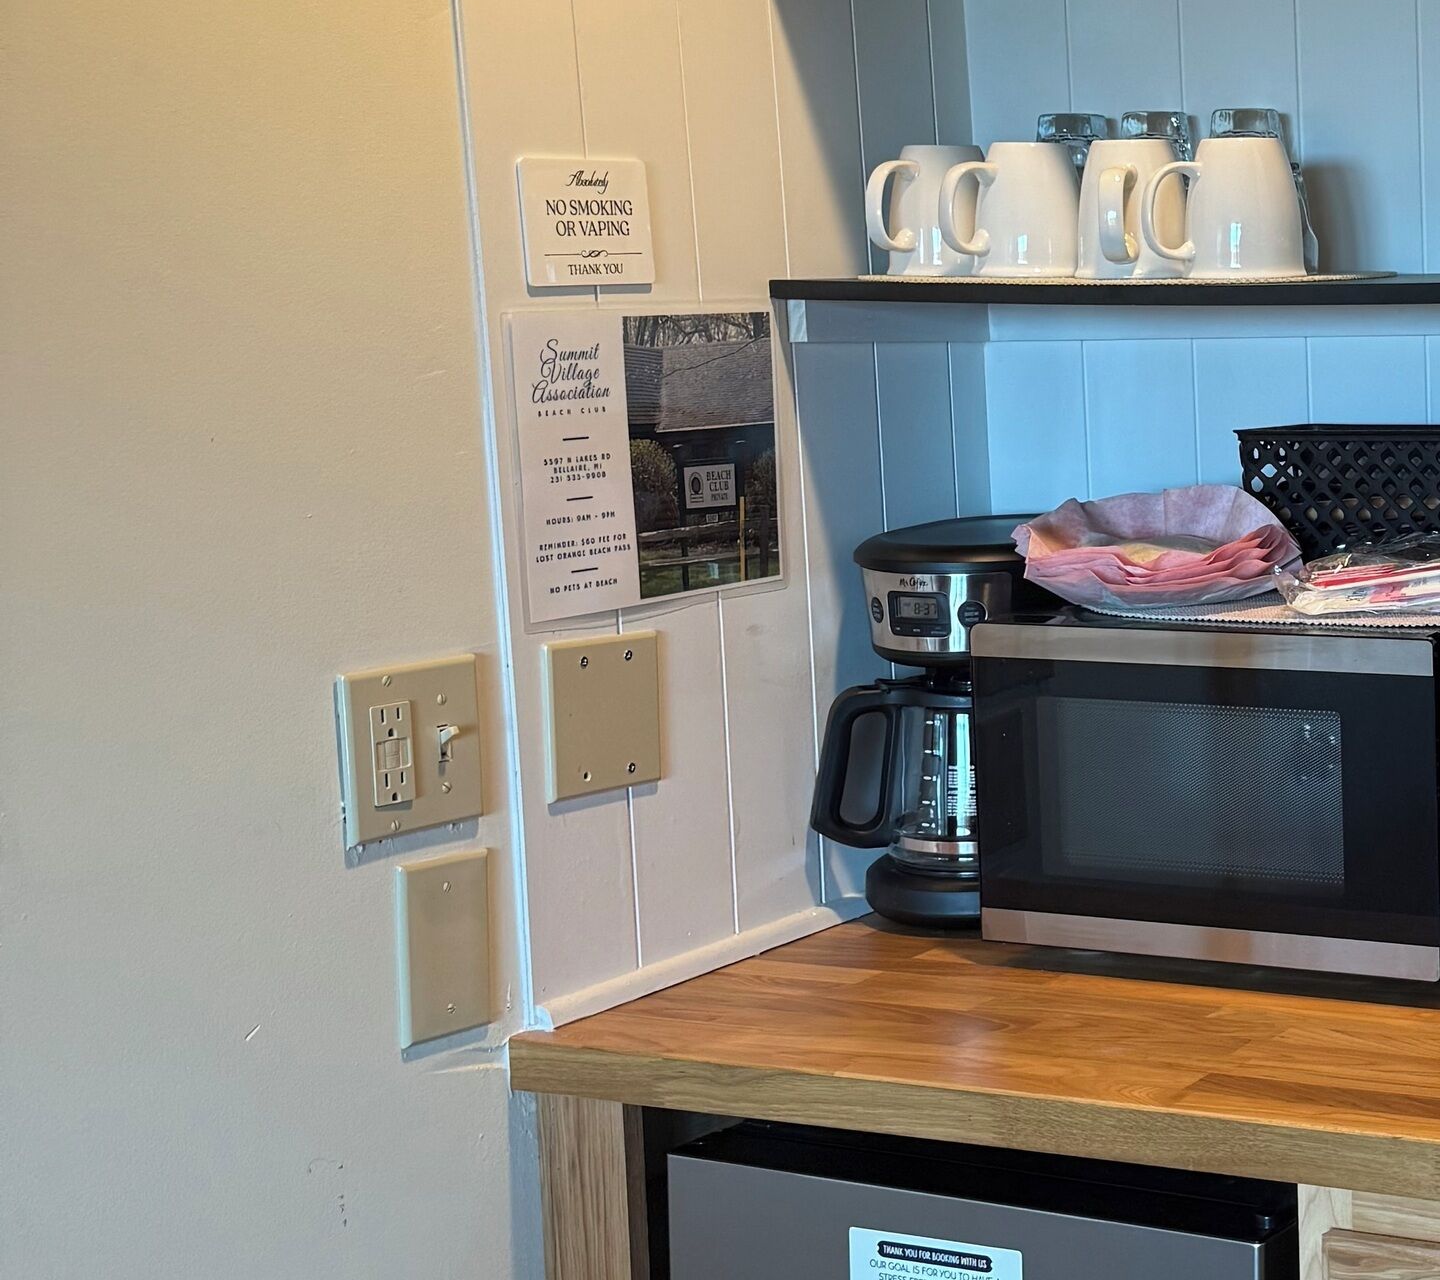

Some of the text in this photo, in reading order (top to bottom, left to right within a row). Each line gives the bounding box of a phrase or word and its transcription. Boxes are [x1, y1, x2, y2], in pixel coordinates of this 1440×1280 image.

[546, 200, 633, 215] NO SMOKING
[556, 220, 630, 236] OR VAPING
[568, 263, 623, 275] THANK YOU
[540, 338, 600, 364] Summit
[540, 358, 600, 388] Village
[532, 380, 610, 403] Association
[538, 406, 606, 417] BEACH CLUB
[706, 470, 731, 481] BEACH
[710, 481, 729, 491] CLUB
[546, 516, 573, 525] HOURS:
[536, 554, 554, 563] LOST
[557, 550, 585, 560] ORANGE
[590, 547, 611, 555] BEACH
[550, 586, 560, 594] NO
[564, 583, 580, 592] PETS
[596, 578, 618, 587] BEACH
[883, 1244, 987, 1268] THANK YOU FOR BOOKING WITH US
[869, 1259, 886, 1269] OUR
[888, 1261, 910, 1273] GOAL
[913, 1265, 920, 1274] IS
[921, 1266, 937, 1277] FOR
[939, 1269, 956, 1280] YOU
[959, 1272, 970, 1280] TO
